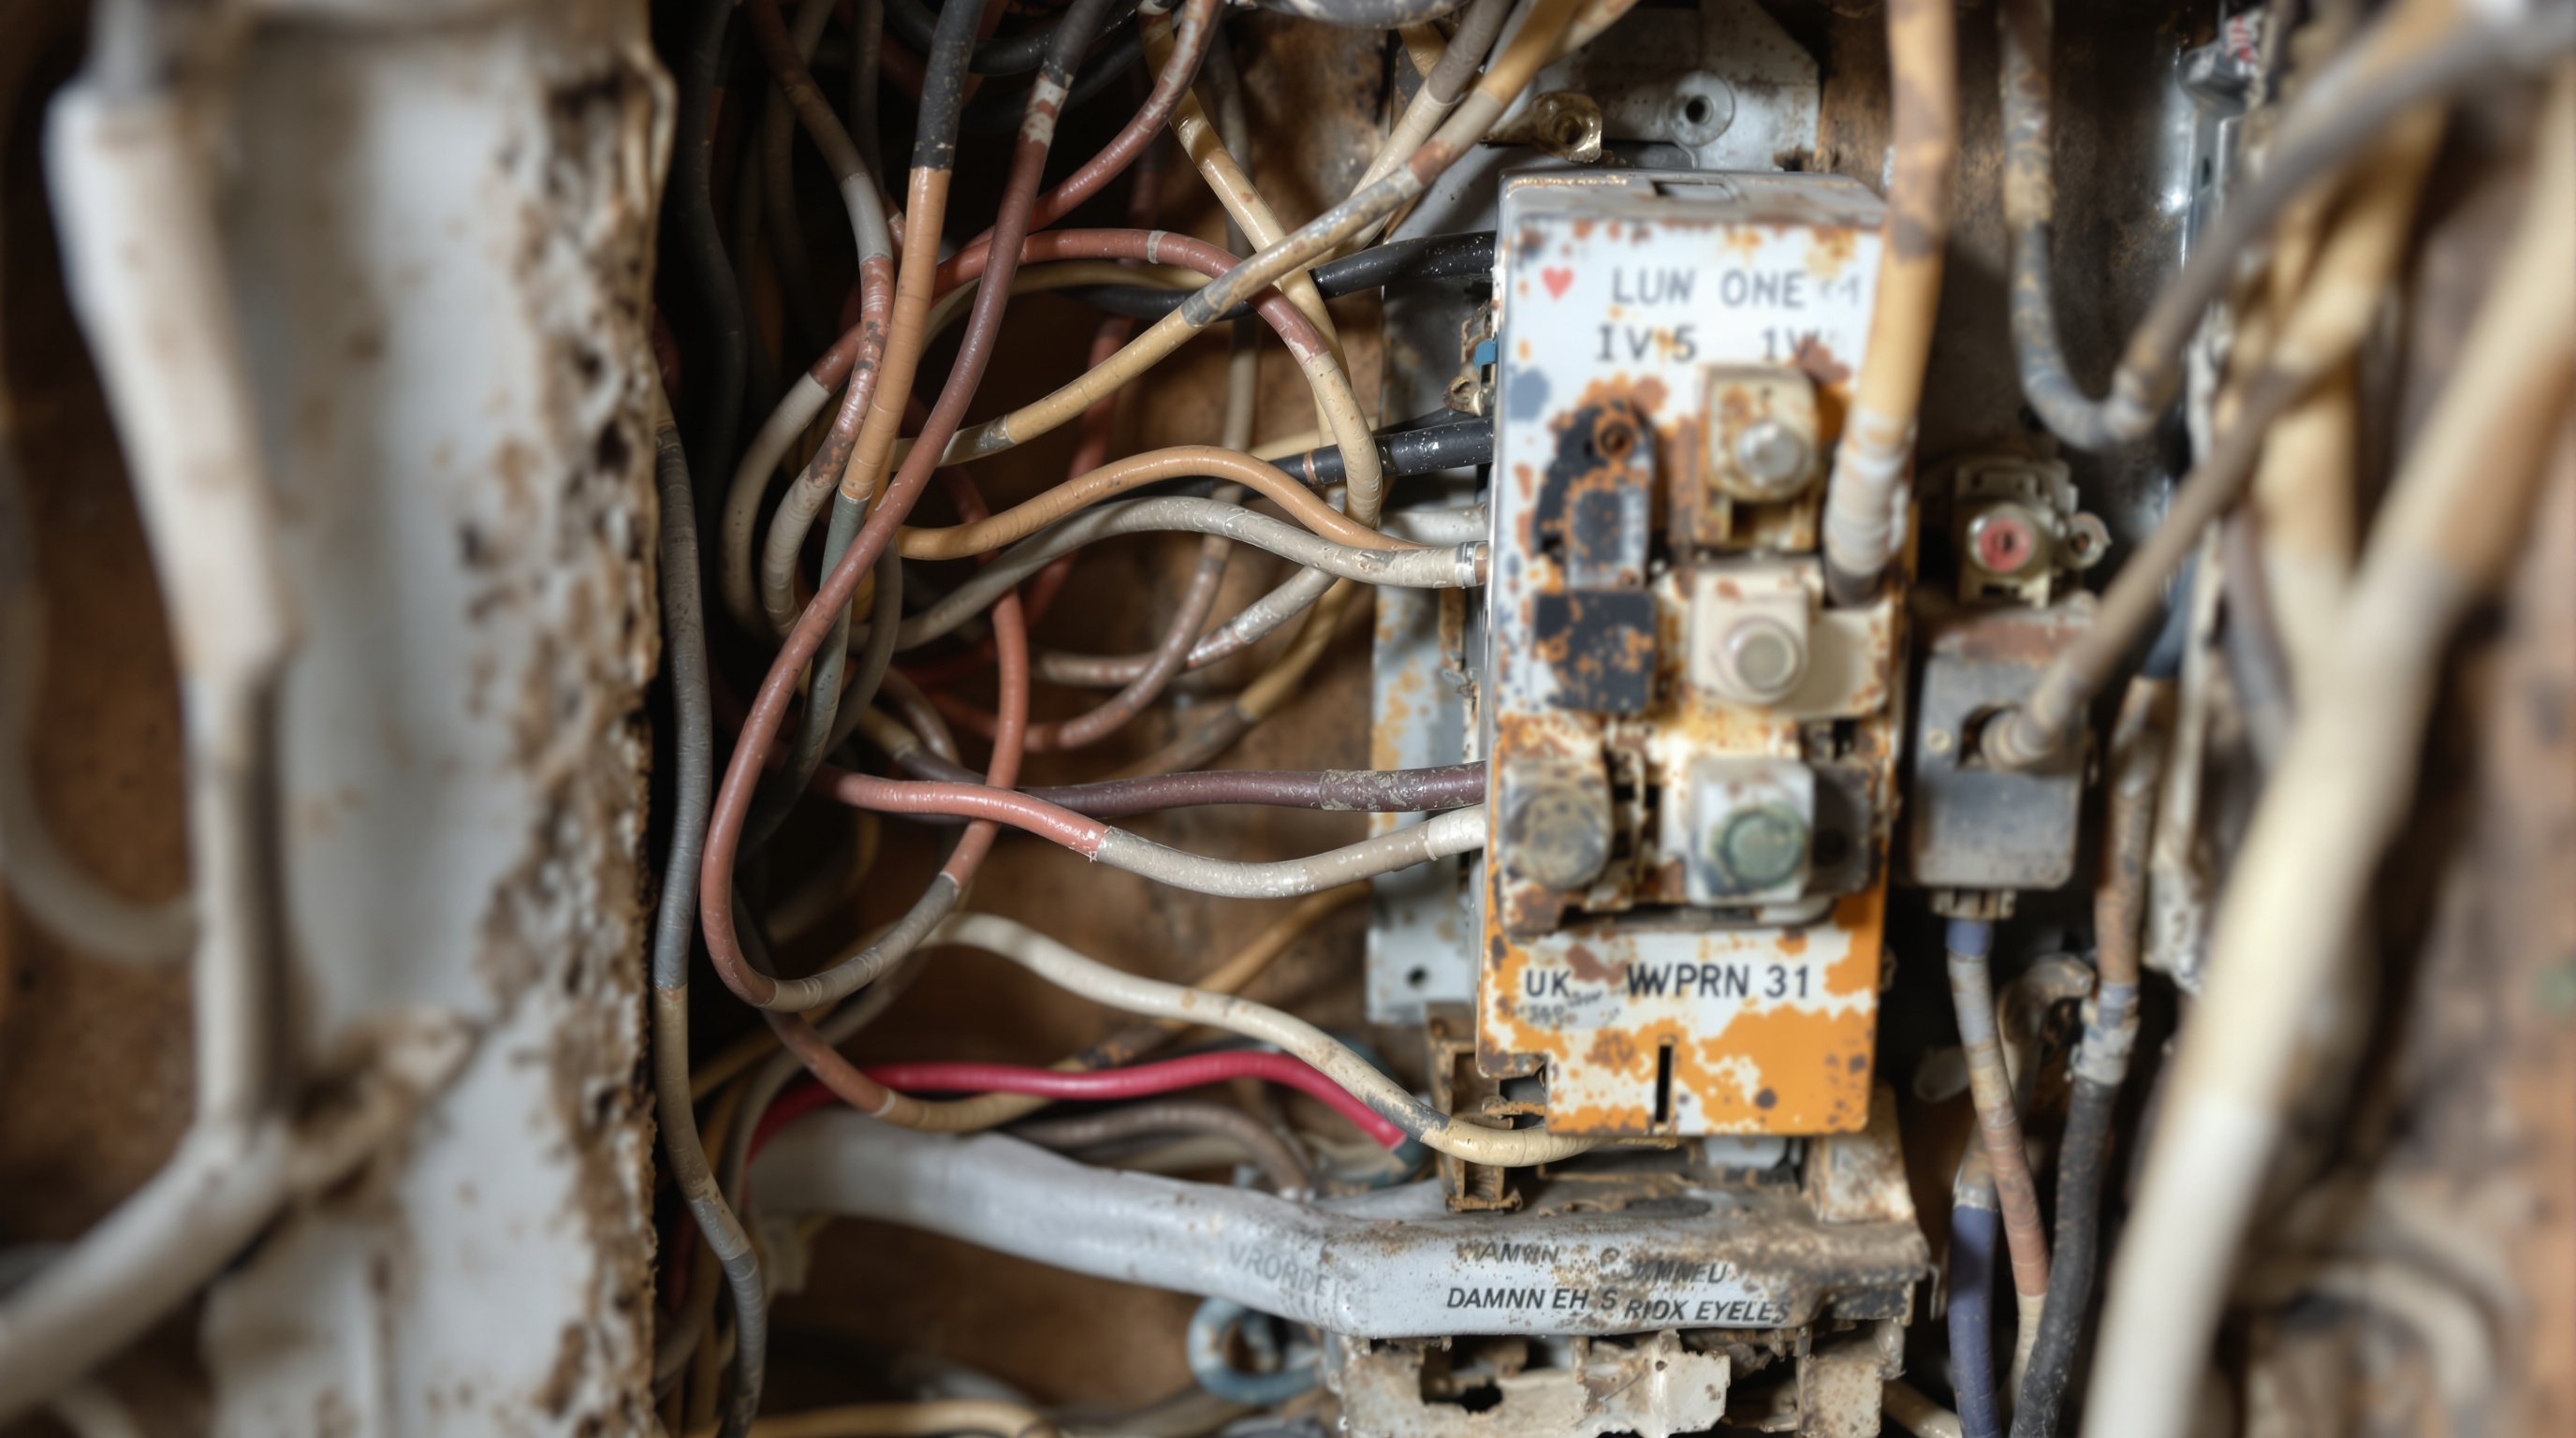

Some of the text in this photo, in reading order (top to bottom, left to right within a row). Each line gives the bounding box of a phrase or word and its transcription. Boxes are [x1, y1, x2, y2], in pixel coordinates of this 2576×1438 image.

[1612, 266, 1696, 305] LUN
[1720, 268, 1808, 309] ONE
[1525, 969, 1572, 998] UK
[1764, 964, 1808, 999] 31
[1446, 1287, 1544, 1309] DAMNN
[1551, 1288, 1590, 1310] EH
